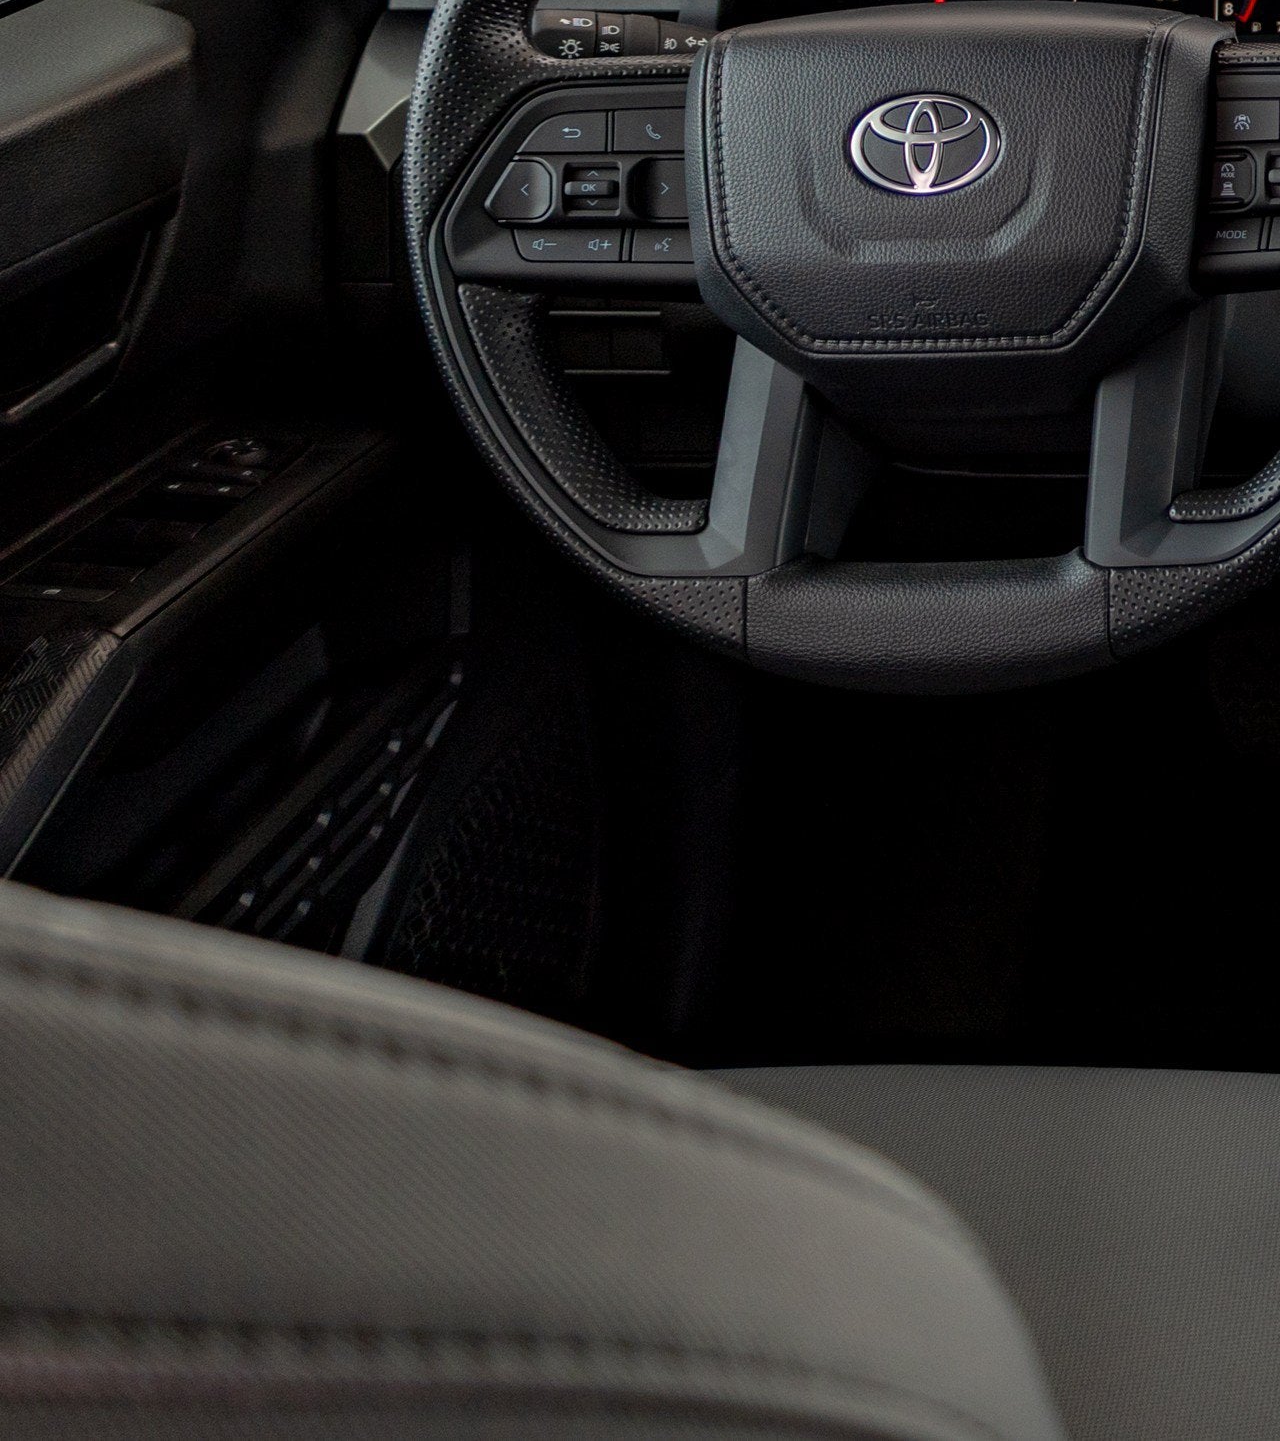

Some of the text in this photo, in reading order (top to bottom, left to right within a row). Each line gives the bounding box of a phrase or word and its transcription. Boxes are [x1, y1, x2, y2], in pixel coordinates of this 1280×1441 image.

[1223, 3, 1235, 16] 8
[581, 183, 596, 193] OK
[1215, 229, 1247, 239] MODE
